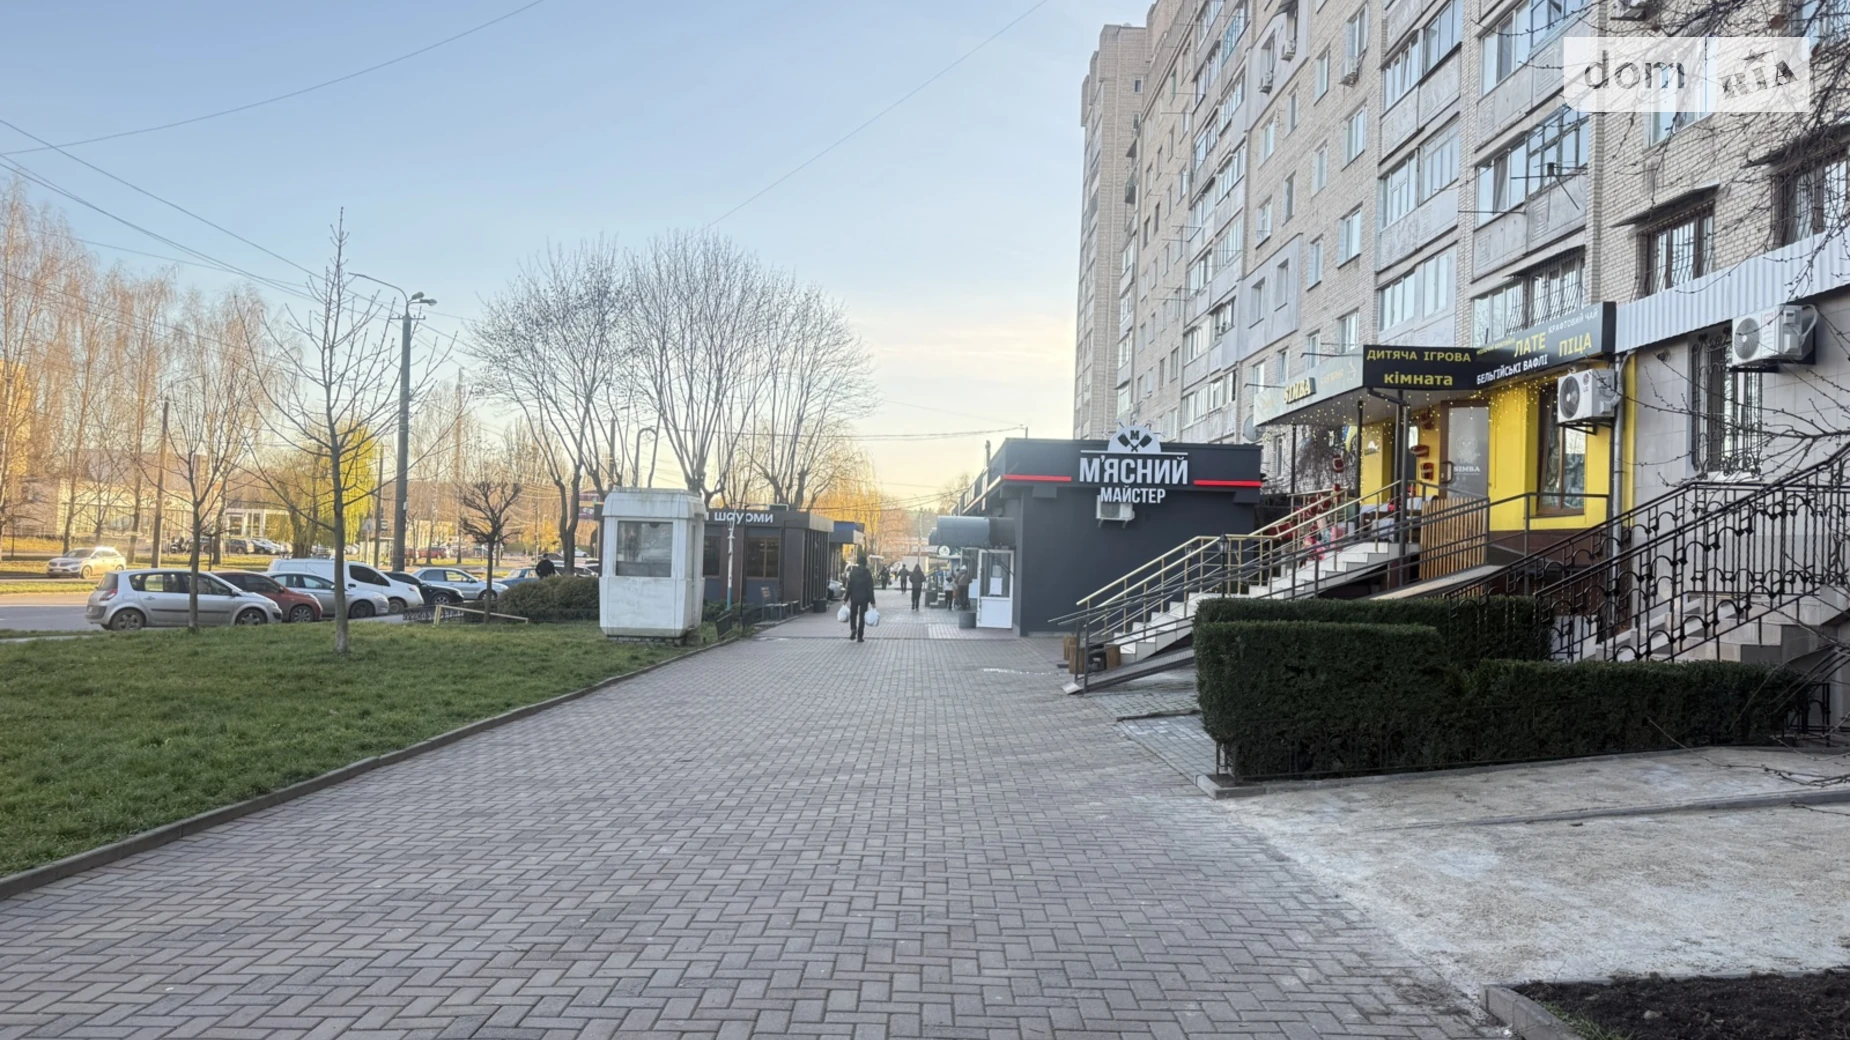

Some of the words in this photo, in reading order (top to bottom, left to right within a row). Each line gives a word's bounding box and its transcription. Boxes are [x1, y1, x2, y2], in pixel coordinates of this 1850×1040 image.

[1514, 332, 1546, 358] ЛАТЕ
[1559, 332, 1592, 357] ПІЦА
[1367, 349, 1418, 361] ДИТЯЧА
[1424, 351, 1472, 362] ІГРОВА
[1384, 371, 1453, 386] кімната
[1476, 362, 1522, 385] БЕЛЬГІЙСЬКІ
[1523, 354, 1548, 371] ВАФЛІ
[1284, 377, 1312, 404] SIMBA
[1453, 465, 1481, 473] SIMBA
[1100, 485, 1166, 503] МАЙСТЕР
